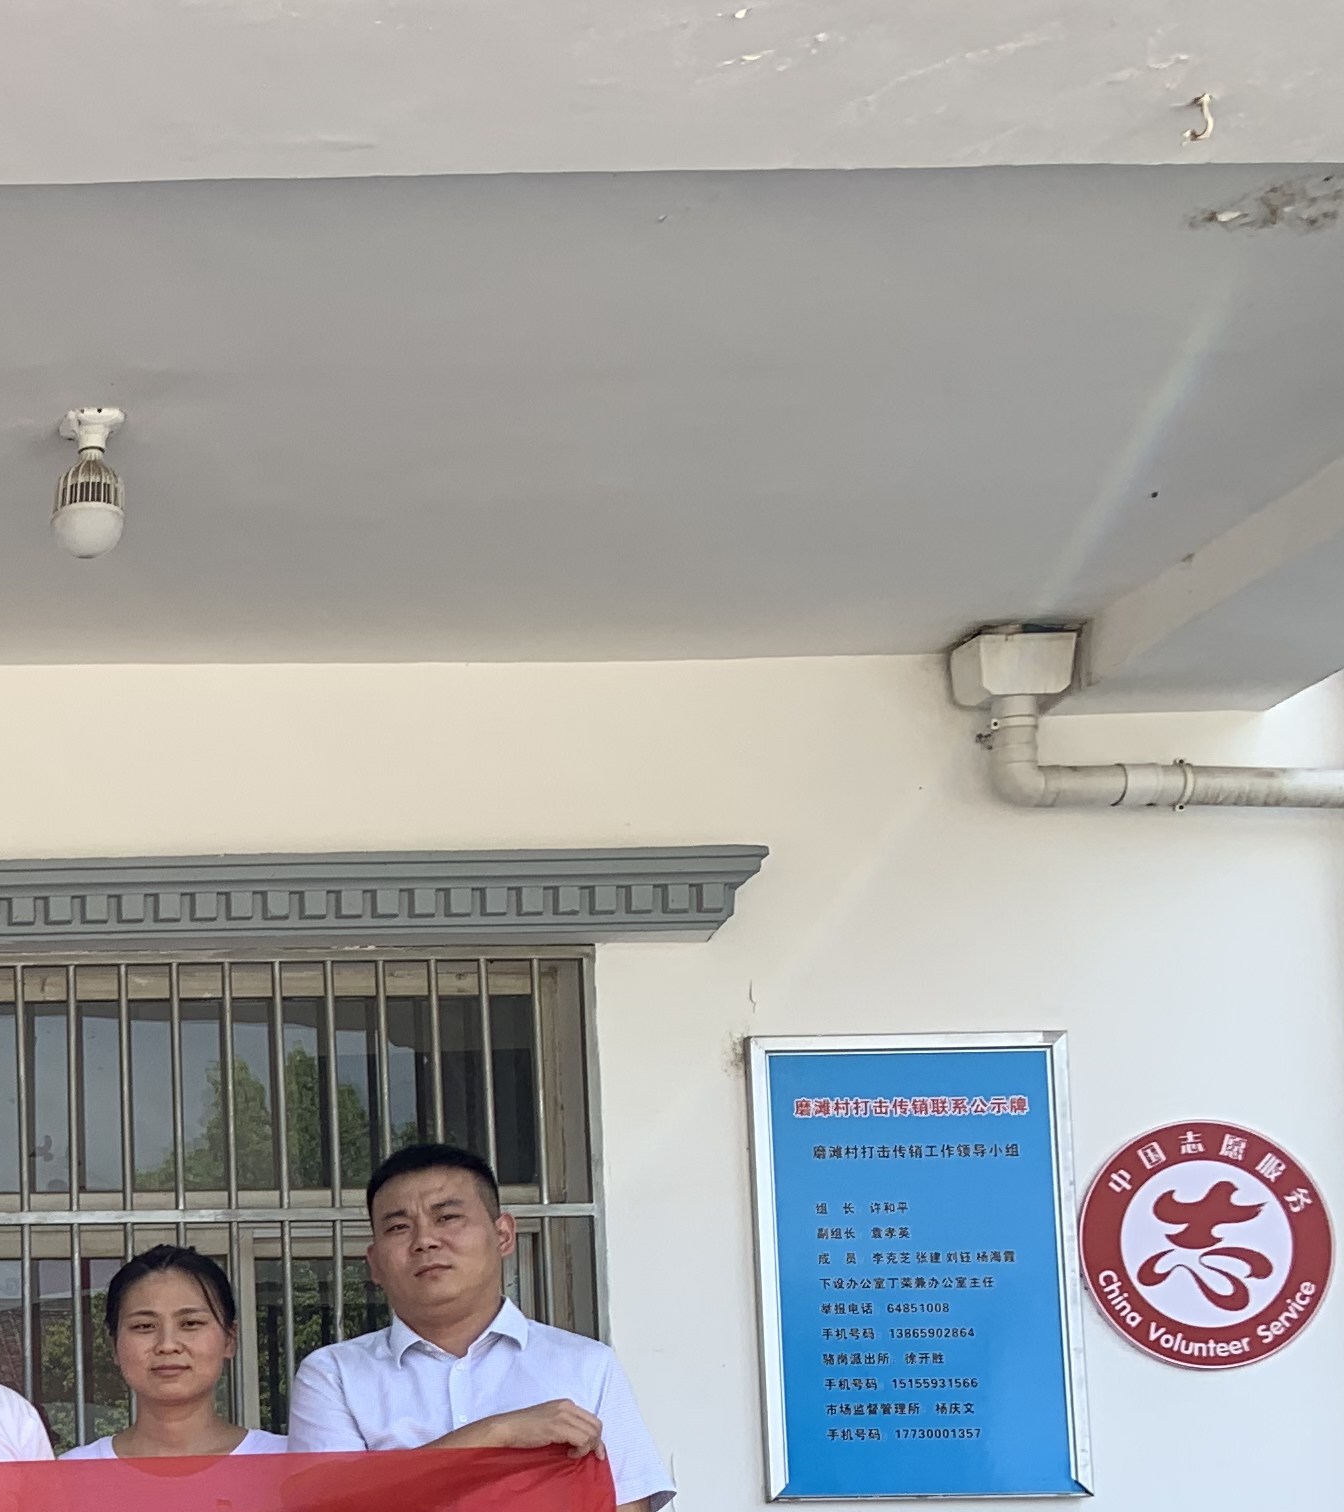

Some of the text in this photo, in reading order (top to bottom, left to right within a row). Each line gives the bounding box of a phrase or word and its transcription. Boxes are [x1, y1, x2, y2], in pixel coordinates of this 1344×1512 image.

[794, 1095, 1030, 1118] 磨滩村打击传销联系公示牌
[812, 1143, 1020, 1160] 磨滩村打击传销工作领导小组
[1108, 1130, 1313, 1213] 中国志愿服务
[1098, 1269, 1317, 1358] China Volunteer Service
